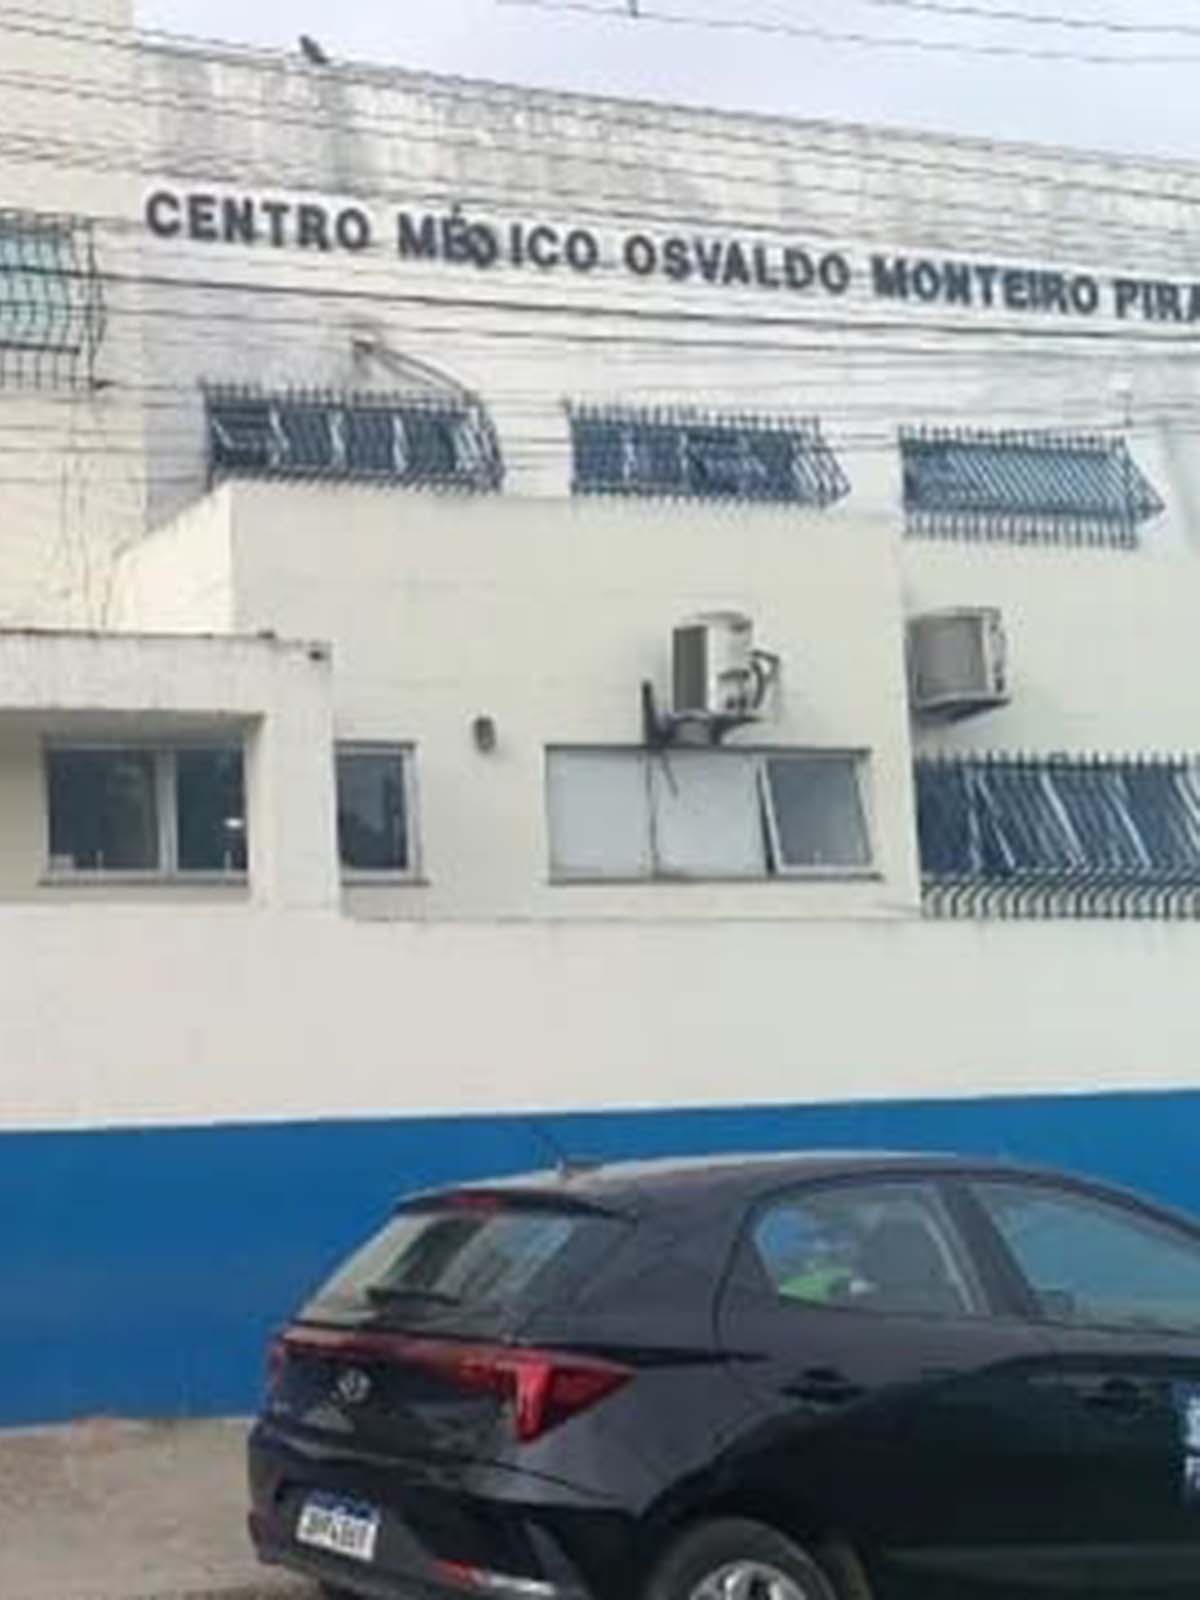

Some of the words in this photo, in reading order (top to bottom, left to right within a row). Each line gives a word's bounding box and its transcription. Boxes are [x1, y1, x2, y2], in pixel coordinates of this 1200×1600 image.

[145, 191, 371, 252] CENTRO
[624, 234, 850, 295] OSVALDO
[872, 254, 1099, 315] MONTEIRO
